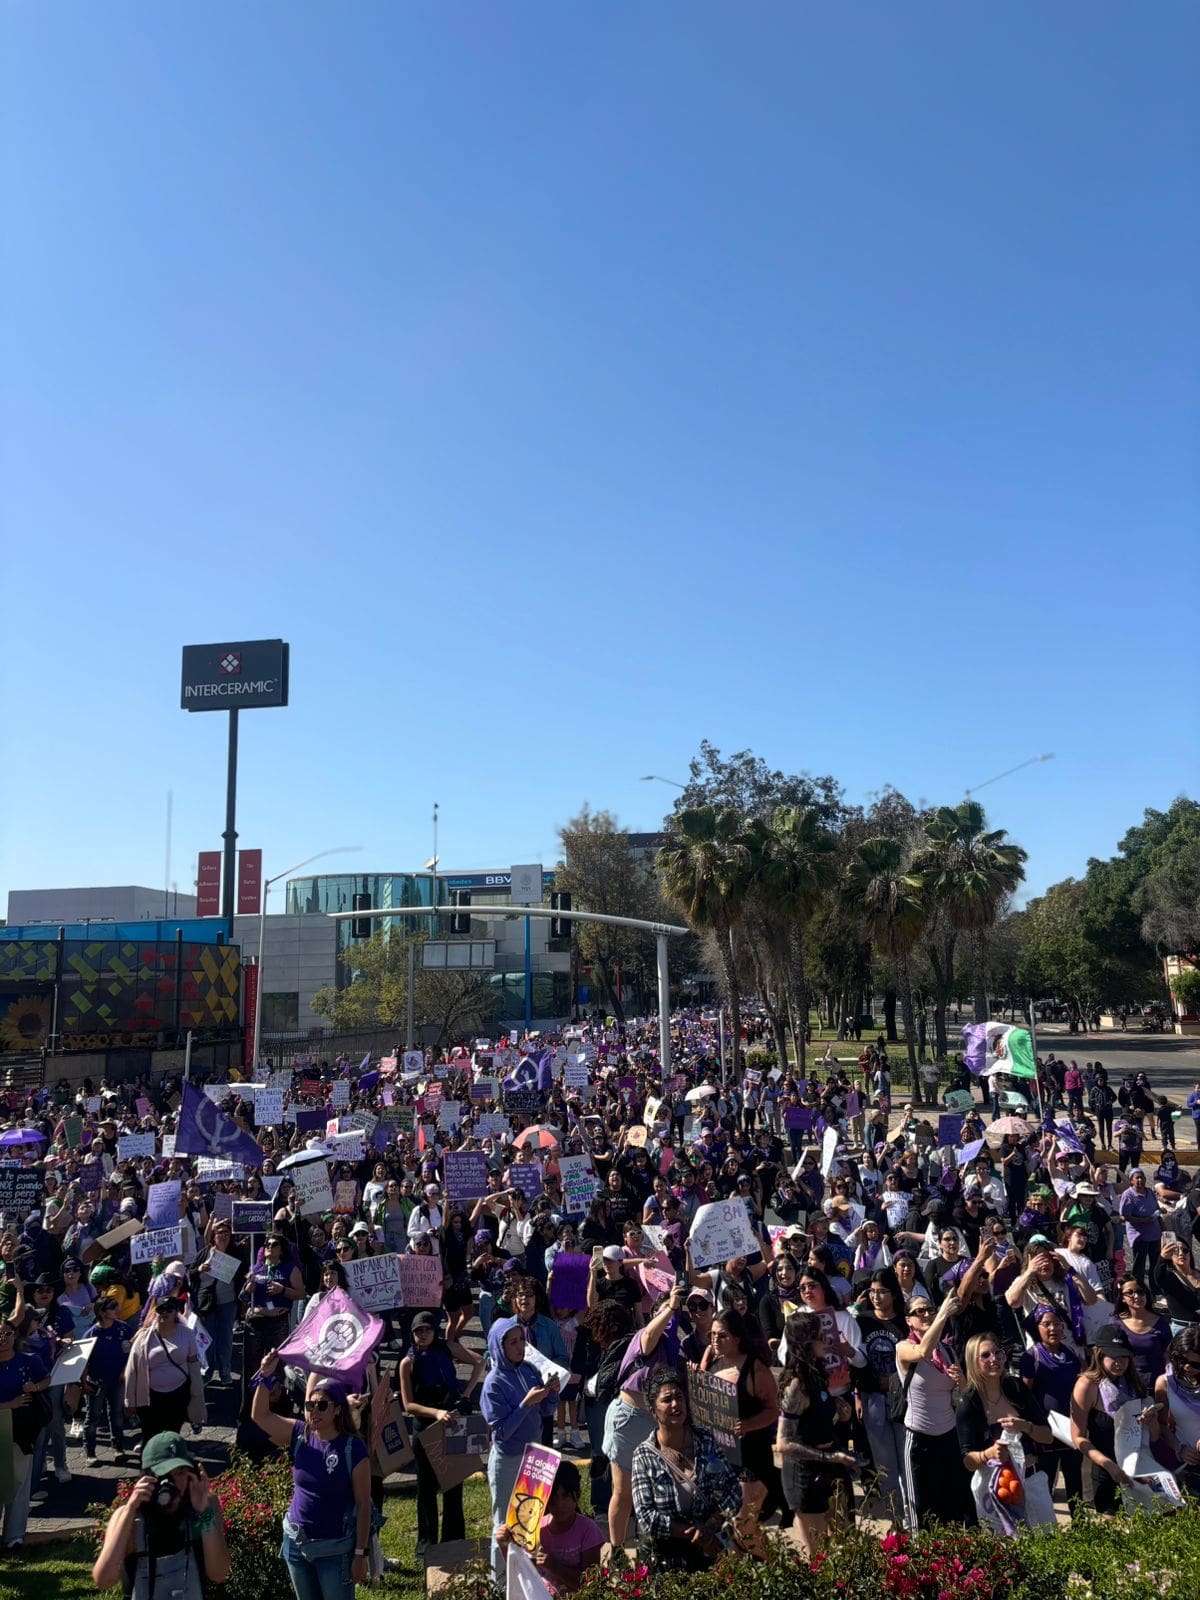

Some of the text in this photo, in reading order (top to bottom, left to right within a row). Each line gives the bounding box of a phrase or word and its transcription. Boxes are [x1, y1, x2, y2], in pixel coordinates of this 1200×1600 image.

[184, 680, 275, 697] INTERCERAMIC
[485, 875, 512, 885] BBV
[15, 1182, 44, 1190] cuando
[14, 1190, 36, 1199] pero
[135, 1249, 145, 1260] LA
[352, 1255, 396, 1276] INFANCIA
[354, 1268, 398, 1288] SE TOCA
